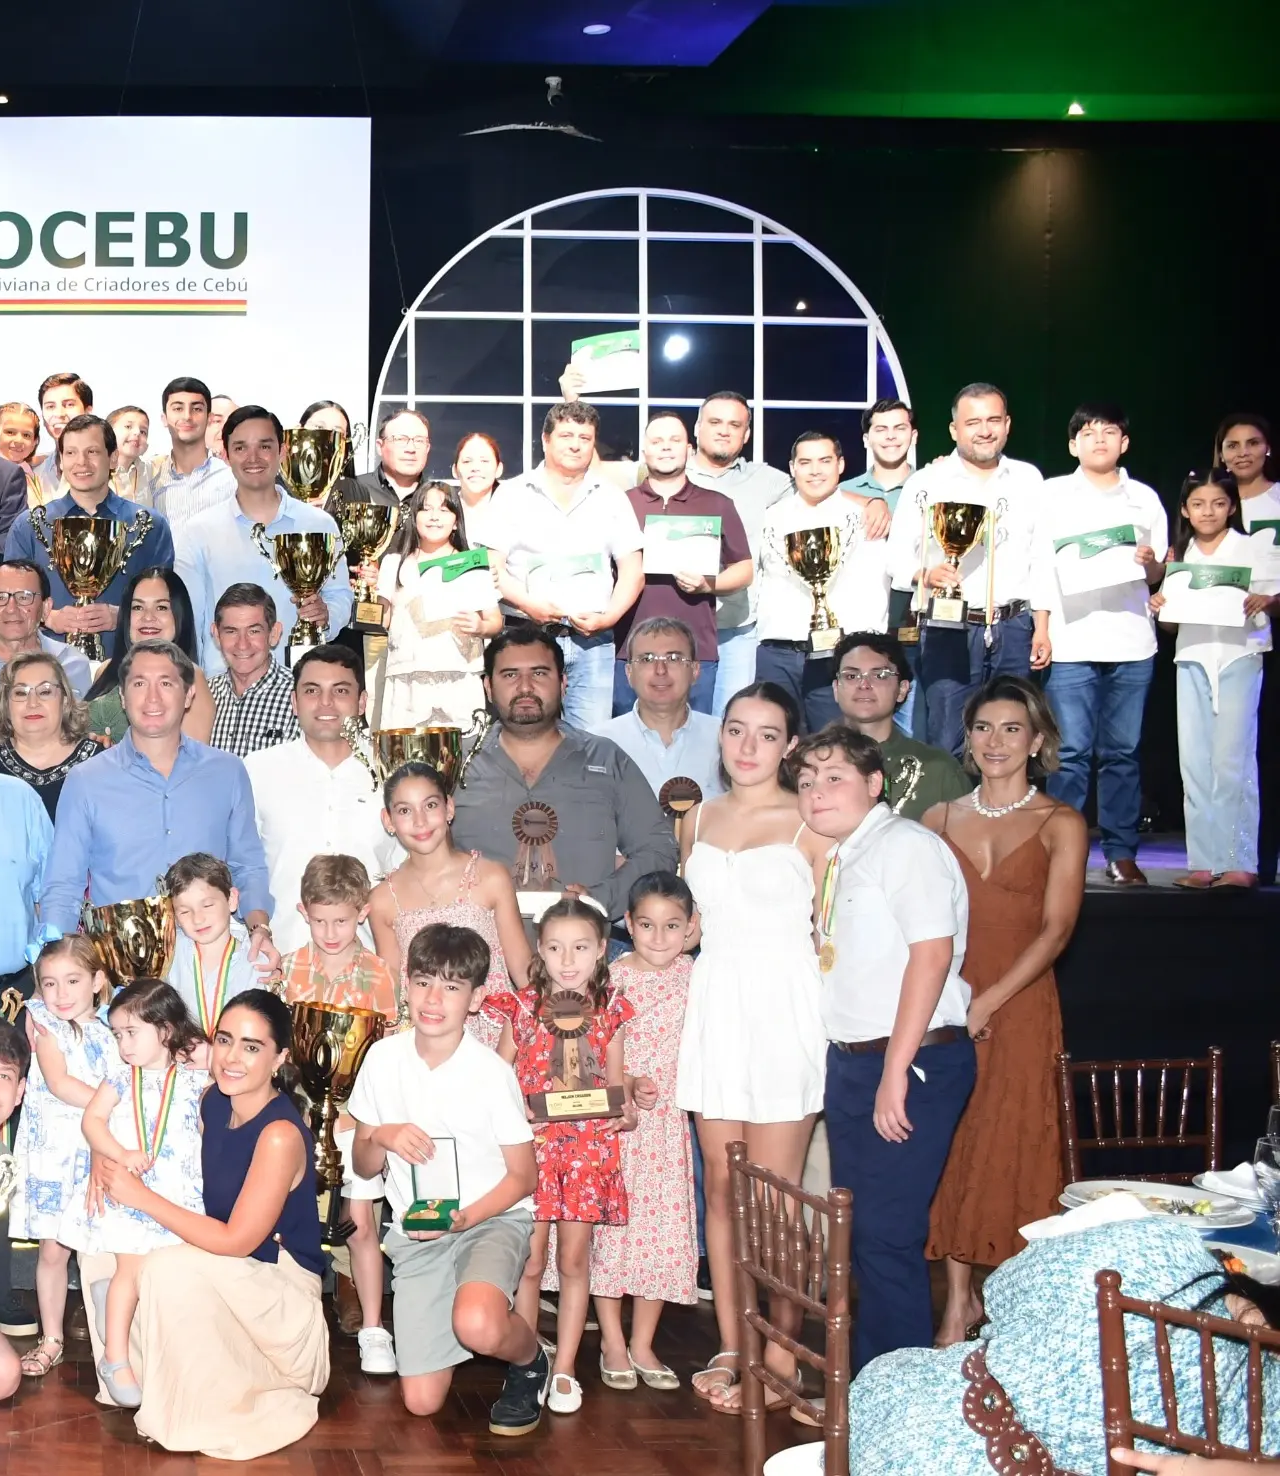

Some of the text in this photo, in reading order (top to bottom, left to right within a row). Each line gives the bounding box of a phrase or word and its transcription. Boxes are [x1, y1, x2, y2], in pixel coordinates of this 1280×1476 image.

[56, 277, 78, 292] de
[84, 277, 170, 292] Criadores
[175, 277, 197, 292] de
[203, 276, 248, 292] Cebú
